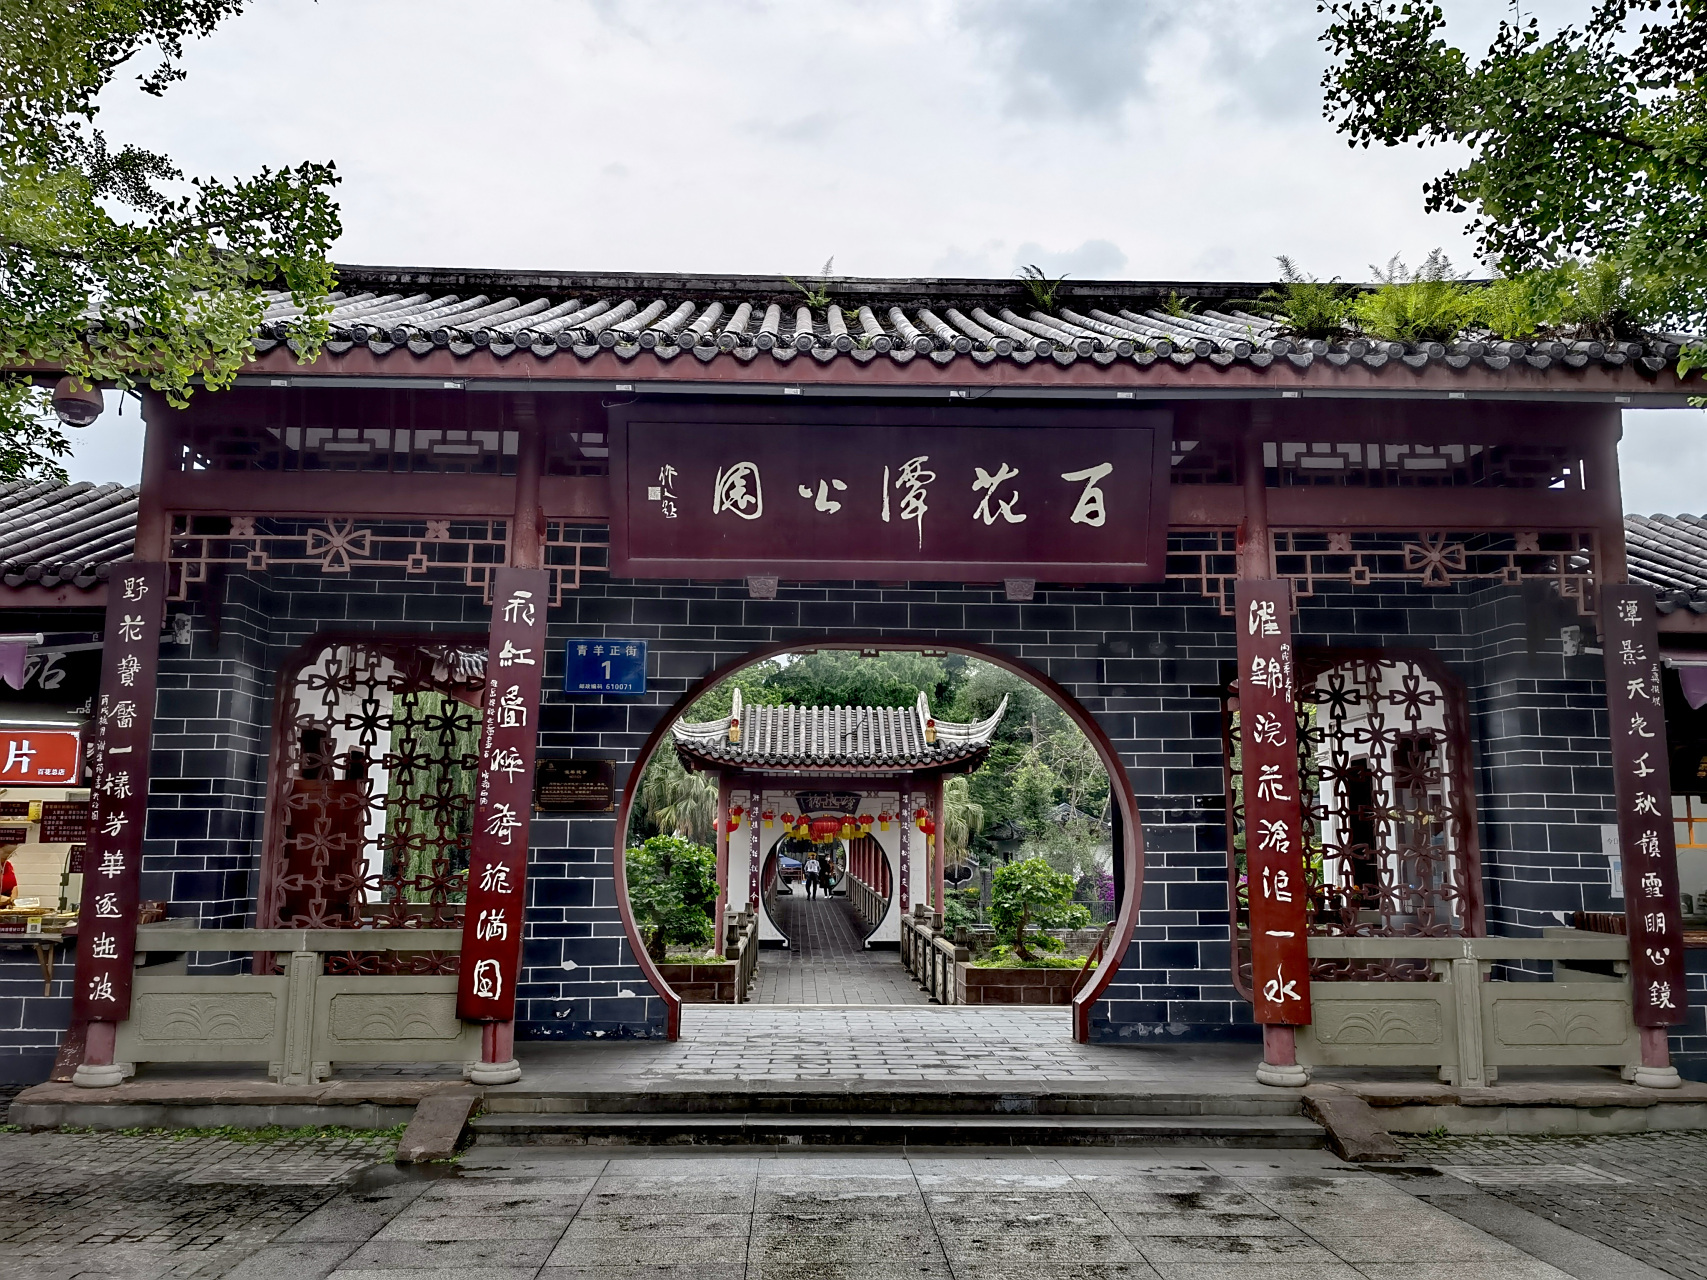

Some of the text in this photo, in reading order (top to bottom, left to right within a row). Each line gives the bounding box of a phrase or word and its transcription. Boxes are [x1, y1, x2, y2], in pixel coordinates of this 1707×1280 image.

[576, 644, 637, 657] 青羊正街
[601, 660, 611, 680] 1
[2, 739, 37, 774] 片
